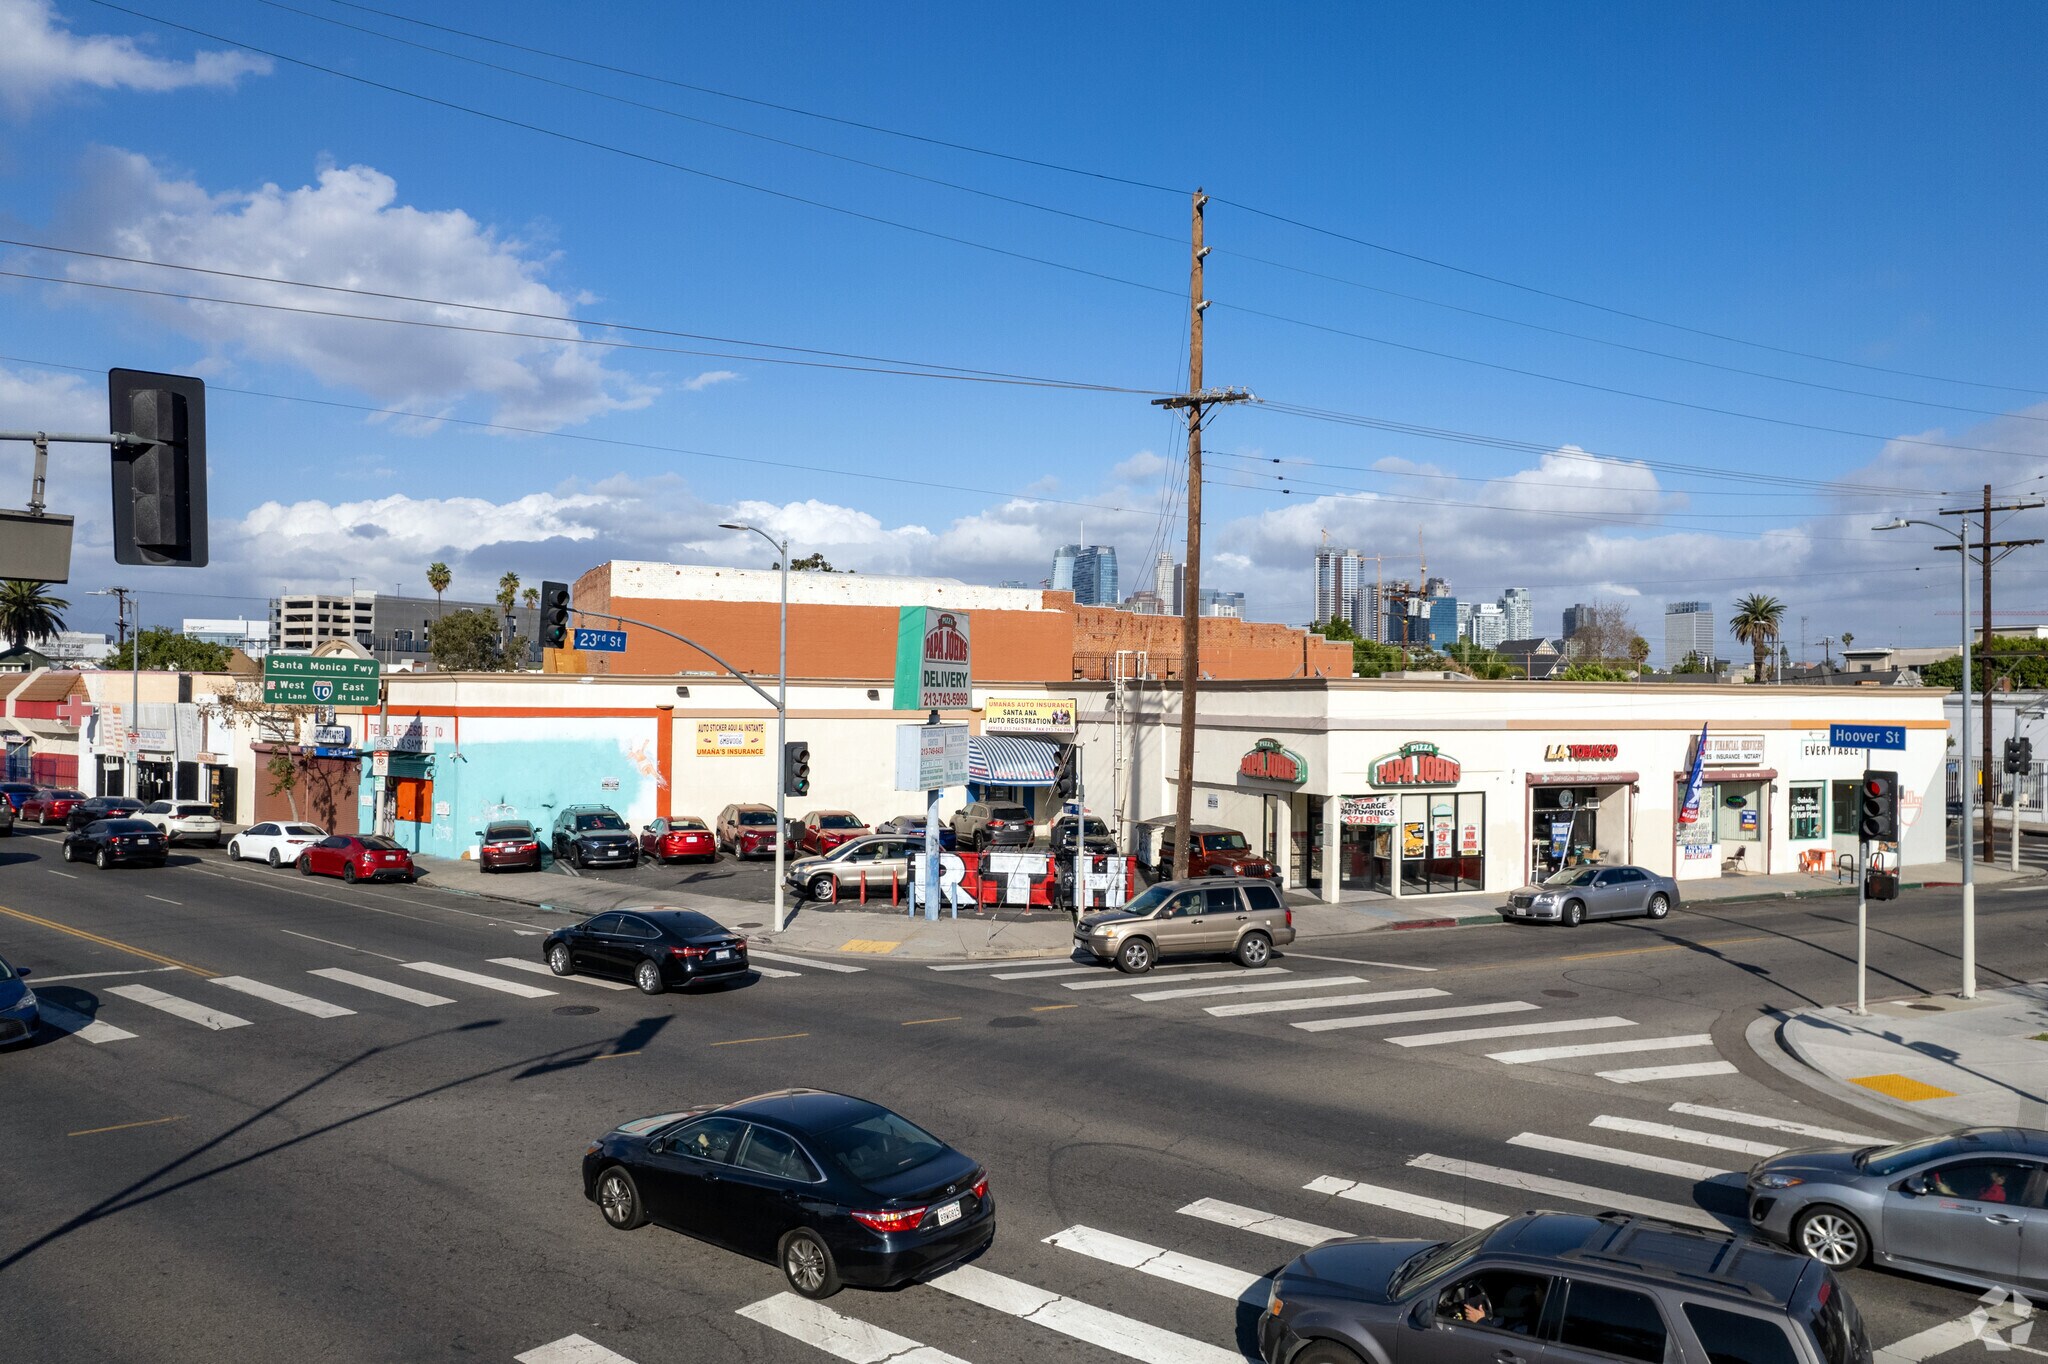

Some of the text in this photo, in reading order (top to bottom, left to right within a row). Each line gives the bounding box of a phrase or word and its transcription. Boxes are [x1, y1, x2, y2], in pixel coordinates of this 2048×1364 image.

[580, 632, 621, 647] 23rd St
[925, 630, 967, 662] PAPA JOHNS
[272, 660, 373, 675] Santa Monica Fwy
[924, 670, 968, 688] DELIVERY
[280, 681, 304, 689] West
[342, 683, 365, 691] East
[316, 687, 330, 697] 10
[924, 692, 968, 706] 213-743-5999
[370, 723, 390, 735] TIEA
[393, 724, 402, 735] DE
[698, 723, 763, 733] AUTO STICKER AQUI AL INSTANTE
[1835, 729, 1900, 744] Hoover St
[406, 740, 428, 751] SAMMY
[1260, 740, 1273, 748] PIZZA
[1410, 744, 1433, 752] PIZZA
[1715, 740, 1739, 750] FINANCIAL
[1741, 740, 1763, 750] SERVICES
[697, 747, 725, 755] UMAÑA'S
[1546, 744, 1618, 760] L.A. TOBACCO
[1805, 745, 1859, 756] EVERYTABLE
[1241, 751, 1297, 780] PAPA JOHNS
[1377, 755, 1460, 783] PAPA JOHNS
[1361, 802, 1387, 810] LARGE
[1346, 815, 1380, 825] $21.99
